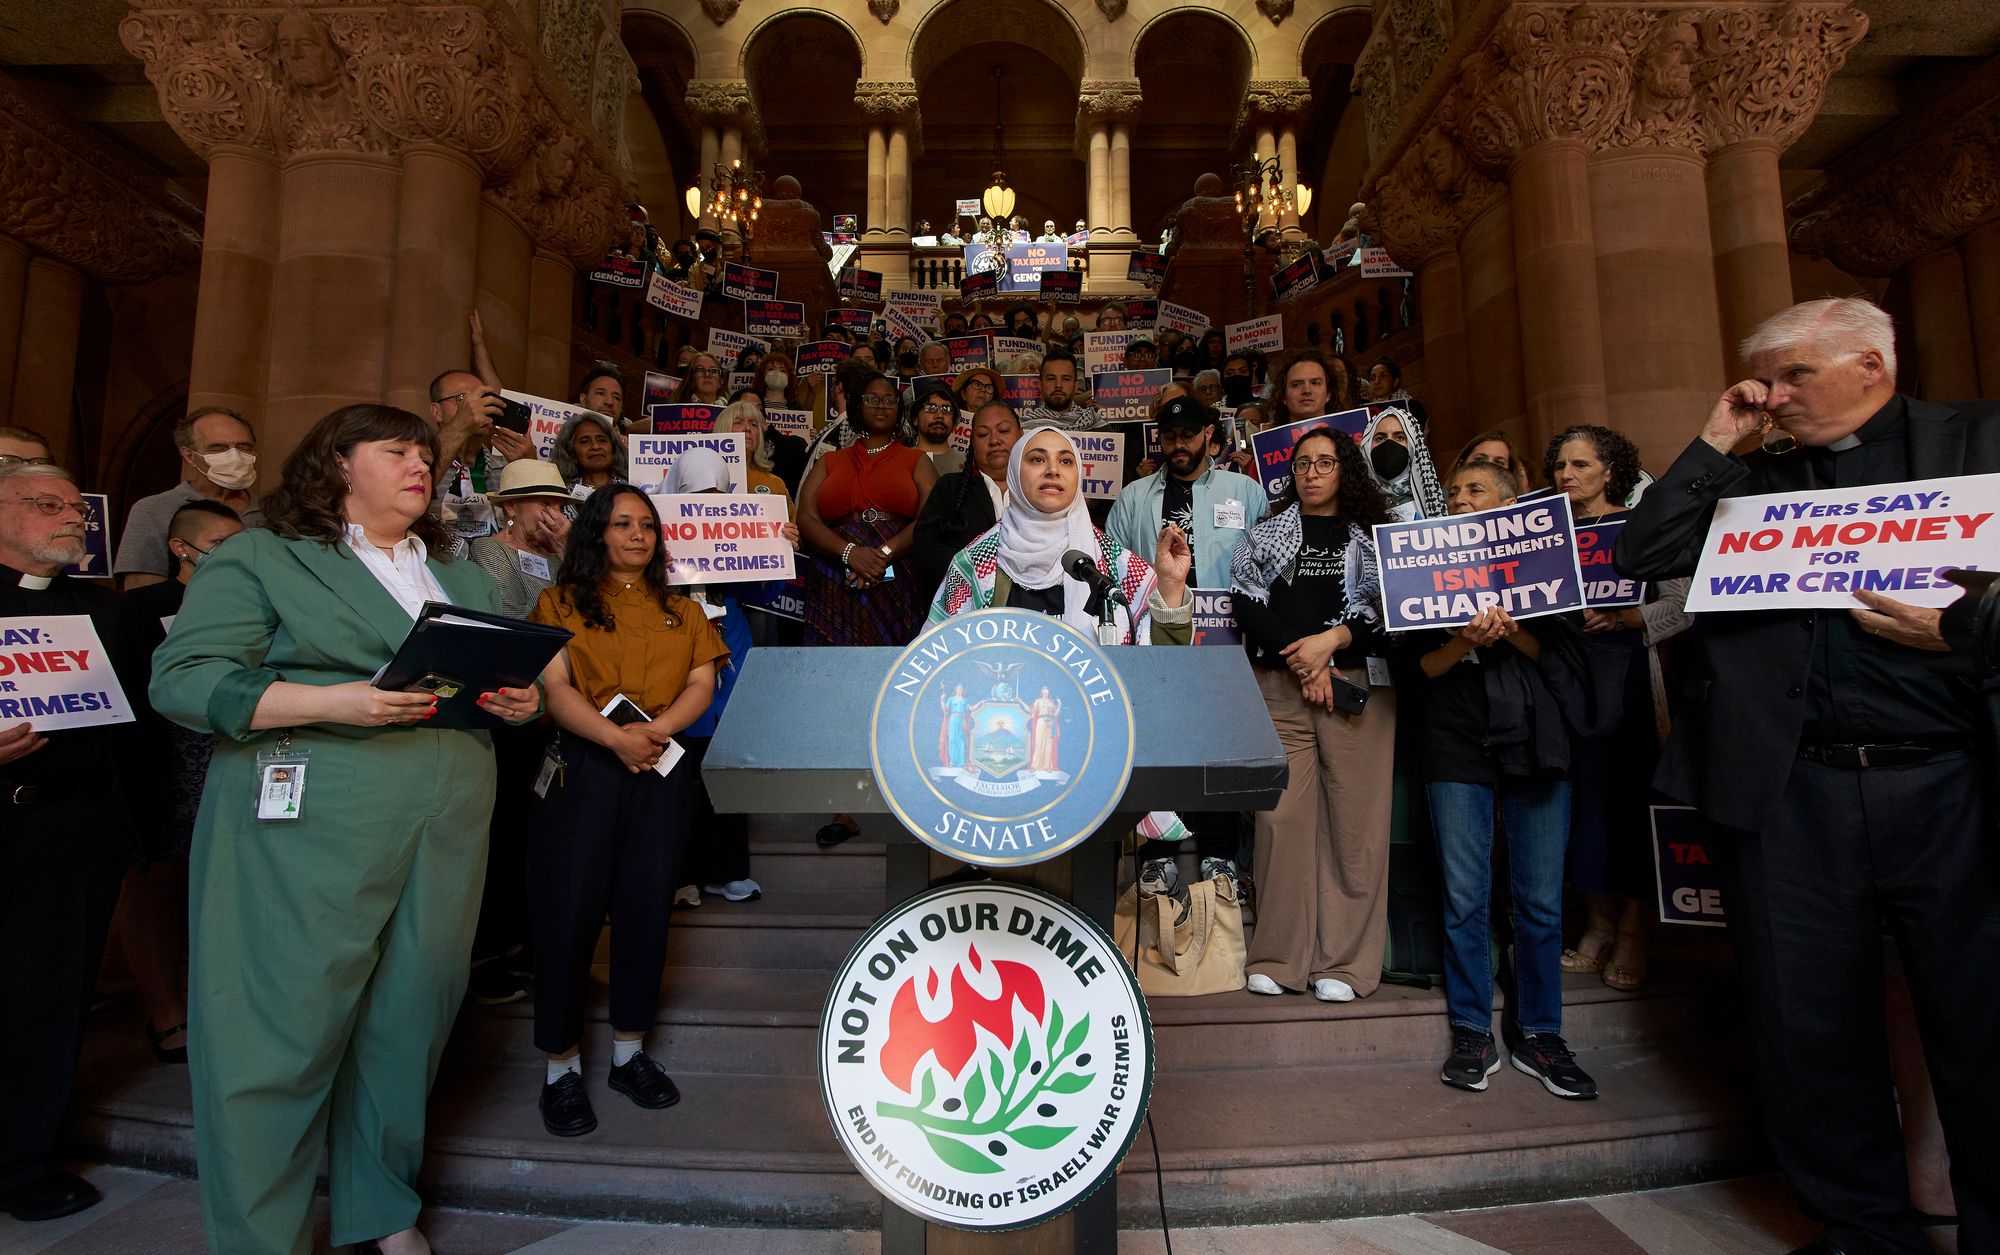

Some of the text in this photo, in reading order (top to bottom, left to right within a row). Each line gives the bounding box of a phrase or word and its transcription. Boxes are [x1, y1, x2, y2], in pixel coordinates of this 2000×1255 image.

[1028, 248, 1046, 257] NO
[1013, 258, 1030, 266] TAX
[1030, 257, 1061, 266] BREAKS
[594, 271, 641, 286] GENOCIDE
[1013, 273, 1041, 282] GENO
[655, 277, 698, 298] FUNDING
[725, 286, 774, 301] GENOCIDE
[1280, 274, 1316, 300] GENOCIDE
[662, 293, 687, 306] ISN'T
[841, 288, 880, 301] GENOCIDE
[891, 292, 937, 303] FUNDING
[1041, 292, 1079, 301] GENOCIDE
[651, 296, 696, 316] CHARITY
[764, 302, 785, 311] NO
[901, 307, 926, 315] ISN'T
[749, 310, 800, 320] TAX BREAKS
[1164, 304, 1205, 323] FUNDING
[889, 308, 927, 343] FUNDING
[912, 316, 936, 325] RITY
[1126, 320, 1157, 328] NOCIDE
[1170, 320, 1193, 332] ISN'T
[750, 324, 801, 335] GENOCIDE
[1229, 326, 1278, 344] NO MONEY
[715, 332, 766, 351] FUNDING
[818, 343, 839, 351] NO
[998, 339, 1042, 352] FUNDING
[800, 351, 849, 361] TAX BREAK
[1104, 353, 1124, 362] ISN
[797, 363, 838, 375] GENOC
[948, 362, 986, 373] NOCIDE
[1091, 364, 1127, 373] CHAR
[1119, 374, 1145, 386] NO
[649, 388, 670, 398] TAX
[1002, 390, 1040, 398] AX BRE
[1098, 386, 1159, 398] TAX BREAK
[681, 407, 711, 419] NO
[766, 411, 806, 423] NDING
[1098, 406, 1150, 419] GENOCI
[656, 420, 715, 431] TAX BREA
[770, 422, 809, 430] TTLEMENTS
[543, 436, 556, 445] FO
[954, 437, 969, 445] FOR
[1070, 438, 1115, 451] DING
[635, 457, 673, 466] ILLEGAL
[1080, 454, 1119, 462] LEMENTS
[680, 503, 764, 517] NYERS SAY:
[1763, 491, 1950, 522] NYERS SAY:
[662, 521, 782, 541] NO MONEY
[1390, 508, 1554, 554] FUNDING
[1718, 512, 1995, 555] NO MONEY
[1576, 531, 1599, 549] O
[714, 543, 738, 552] FOR
[1387, 550, 1447, 570] ILLEGAL
[1449, 533, 1565, 564] SETTLEMENTS
[713, 554, 785, 572] CRIMES!
[1809, 551, 1860, 565] FOR
[1298, 568, 1341, 576] PALESTIN
[1432, 560, 1520, 592] ISN'T
[1710, 573, 1791, 596] WAR
[771, 594, 805, 615] CIDE
[1400, 578, 1564, 621] CHARITY
[1192, 617, 1239, 628] EMENTS
[0, 628, 53, 646] AY:
[0, 650, 89, 676] ONEY
[894, 619, 1115, 706] NEW YORK STATE
[0, 692, 112, 719] RIMES!
[975, 781, 1020, 791] EXCELSIOR
[935, 812, 1057, 851] SENATE
[1668, 842, 1712, 865] TA
[838, 902, 1106, 1064] NOT ON OUR DIME
[848, 1014, 1130, 1209] END NY FUNDING OF ISRAELI WAR CRIMES
